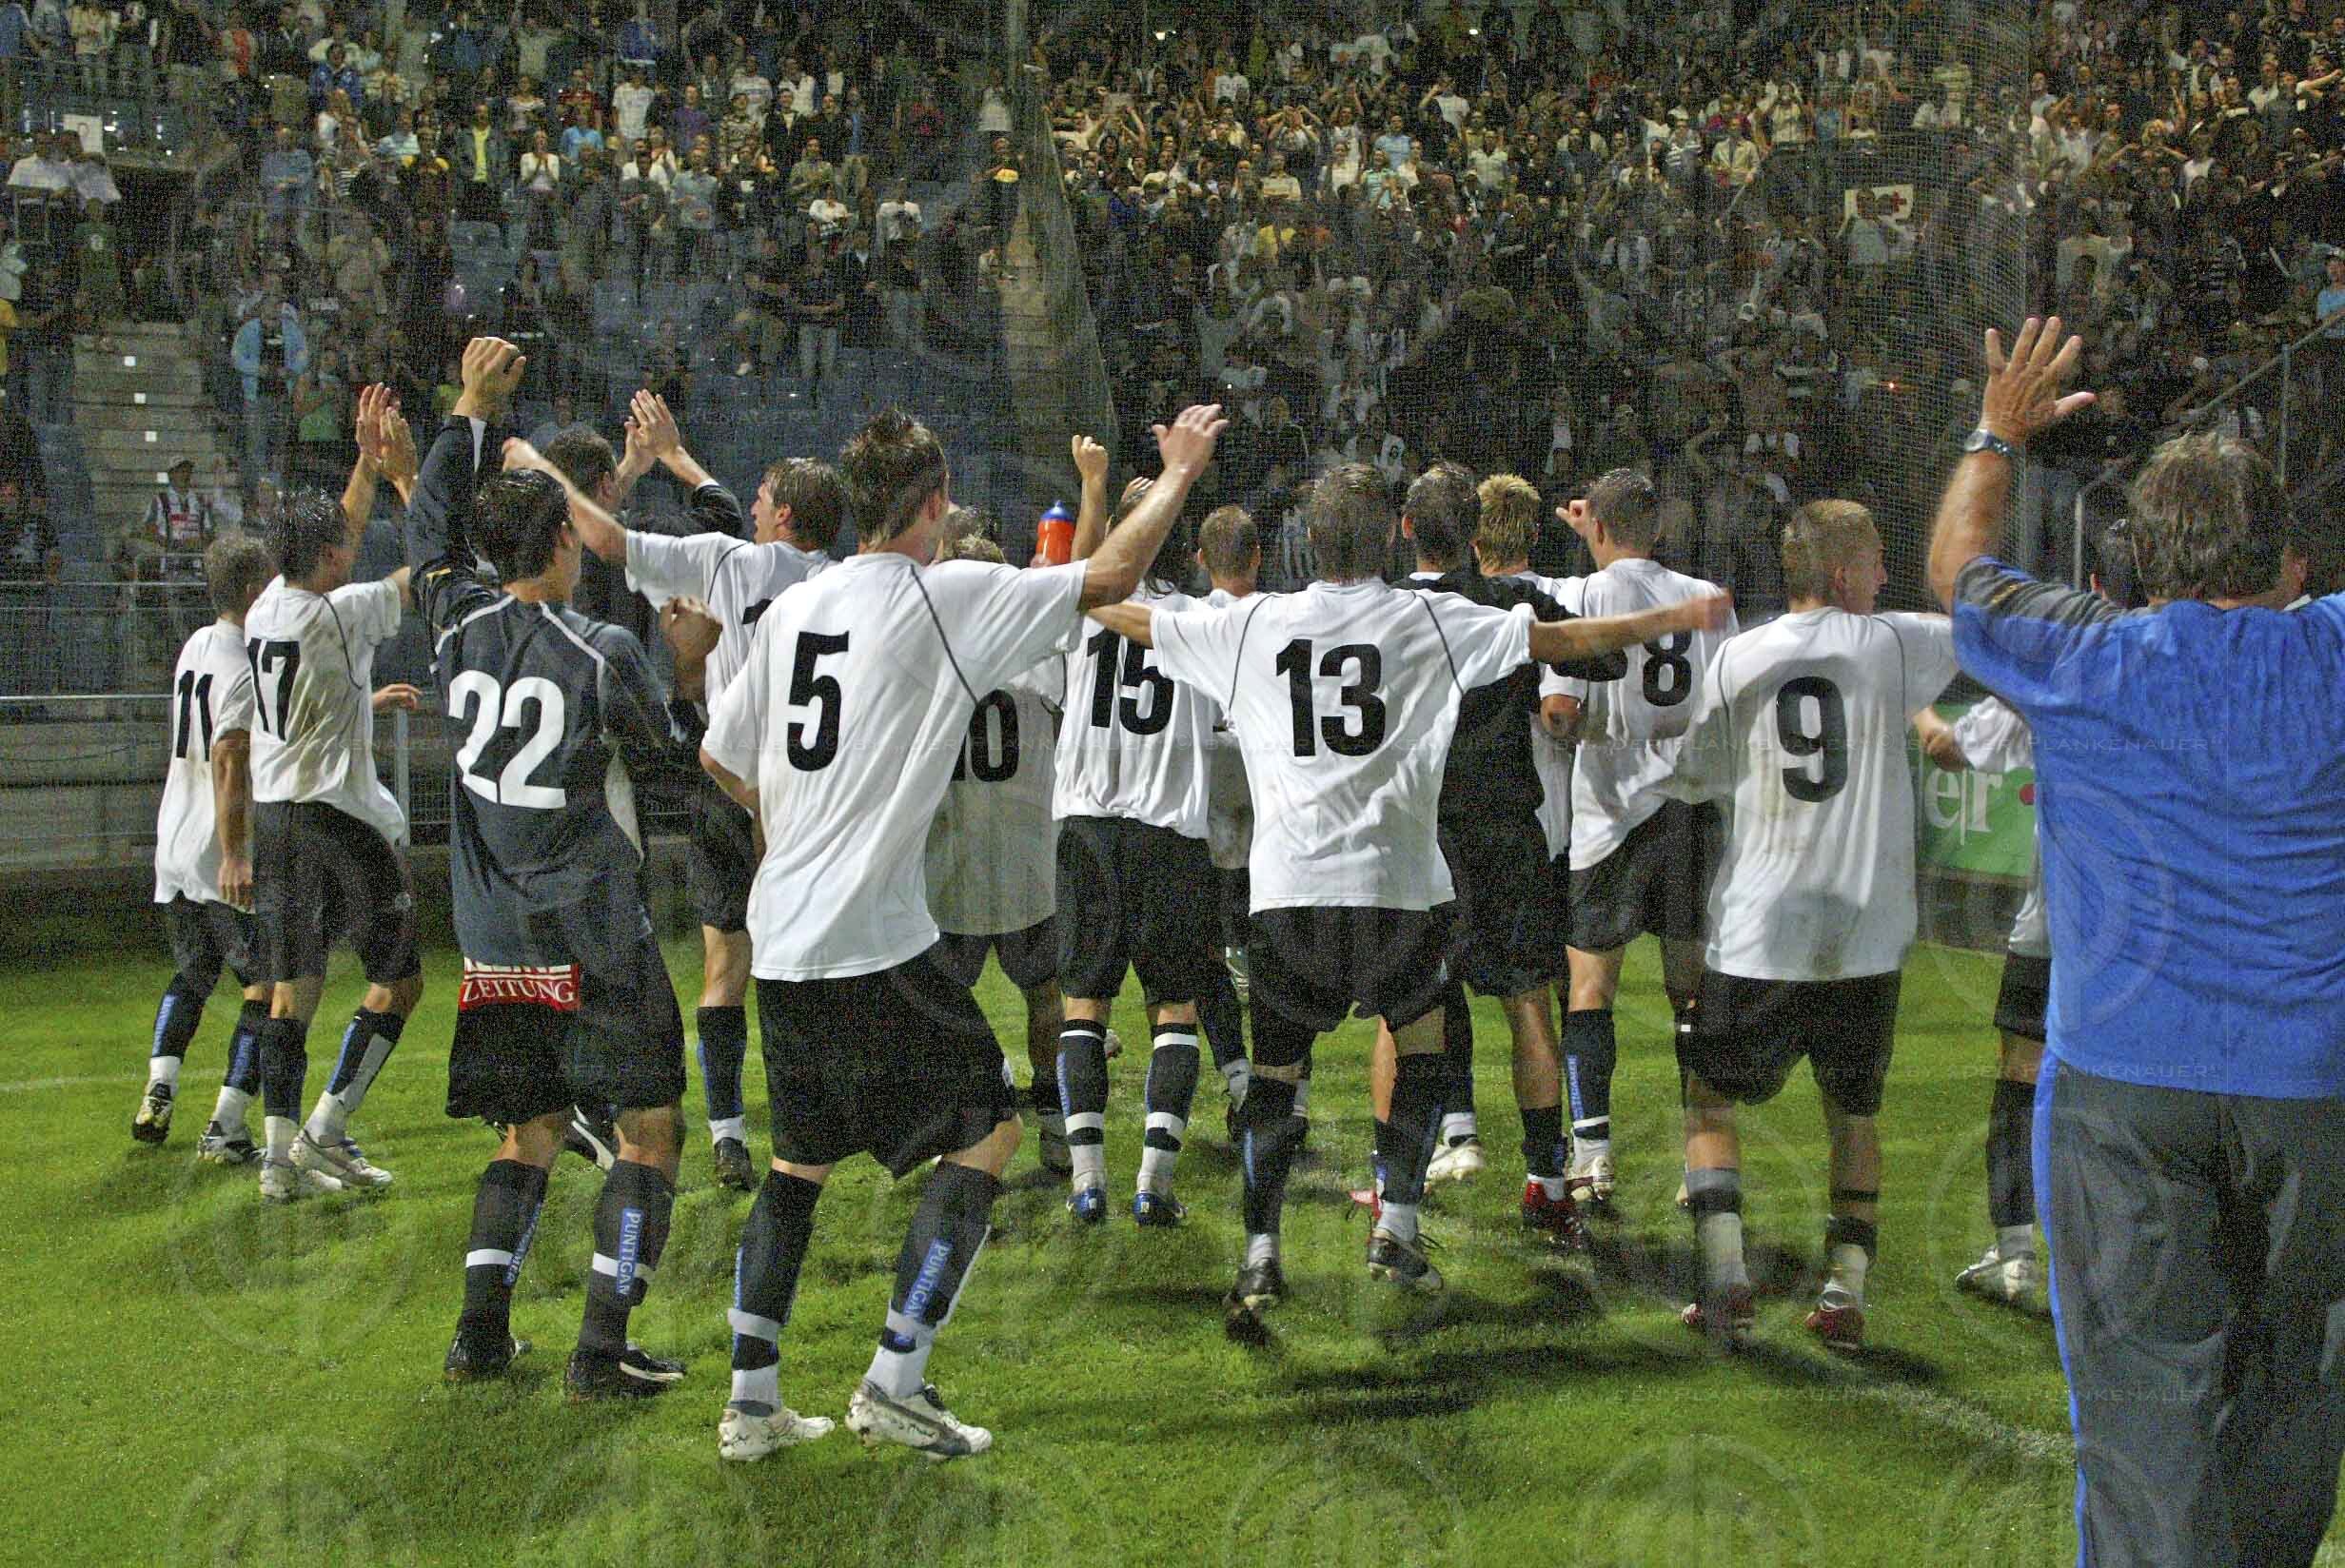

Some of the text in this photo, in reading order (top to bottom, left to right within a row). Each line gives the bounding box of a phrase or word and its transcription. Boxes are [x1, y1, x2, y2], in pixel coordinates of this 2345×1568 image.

[175, 670, 214, 763] 11
[249, 637, 300, 742] 17
[786, 631, 849, 772] 5
[1087, 628, 1174, 735] 15
[1275, 638, 1386, 758] 13
[448, 670, 566, 811] 22
[1776, 676, 1848, 803] 9
[463, 980, 574, 1004] ZEITUNG
